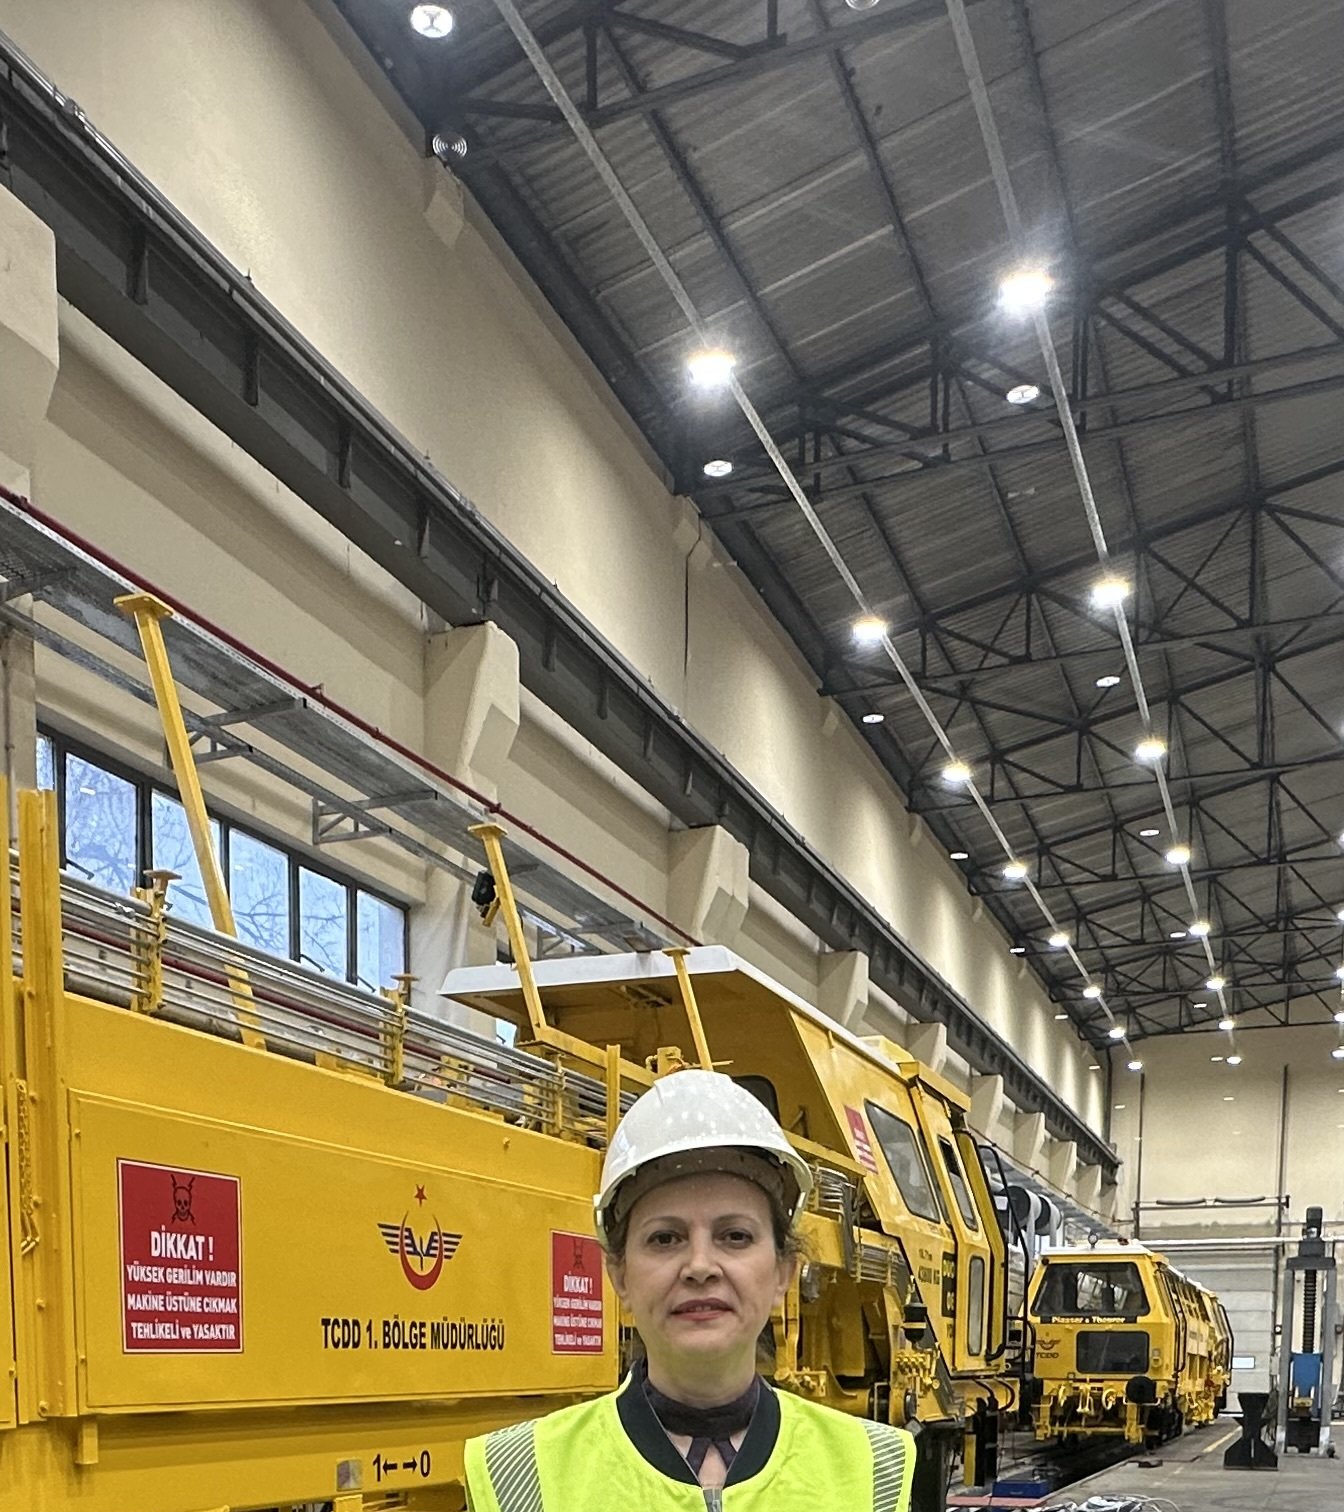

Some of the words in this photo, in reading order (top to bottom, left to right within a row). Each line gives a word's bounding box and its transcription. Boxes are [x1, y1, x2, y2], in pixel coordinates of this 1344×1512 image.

[150, 1225, 206, 1261] DİKKAT
[208, 1236, 214, 1261] !
[127, 1261, 165, 1284] YÜKSEK
[166, 1264, 204, 1285] GERİLİM
[205, 1270, 237, 1288] VARDIR
[127, 1290, 165, 1311] MAKİNE
[166, 1291, 203, 1313] ÜSTÜNE
[131, 1318, 180, 1340] TEHLİKELİ
[180, 1326, 192, 1340] ve
[192, 1323, 235, 1340] YASAKTIR
[321, 1318, 361, 1350] TCDD
[366, 1319, 378, 1350] 1.
[382, 1314, 427, 1350] BÖLGE
[430, 1315, 505, 1351] MÜDÜRLÜĞÜ
[372, 1453, 381, 1482] 1
